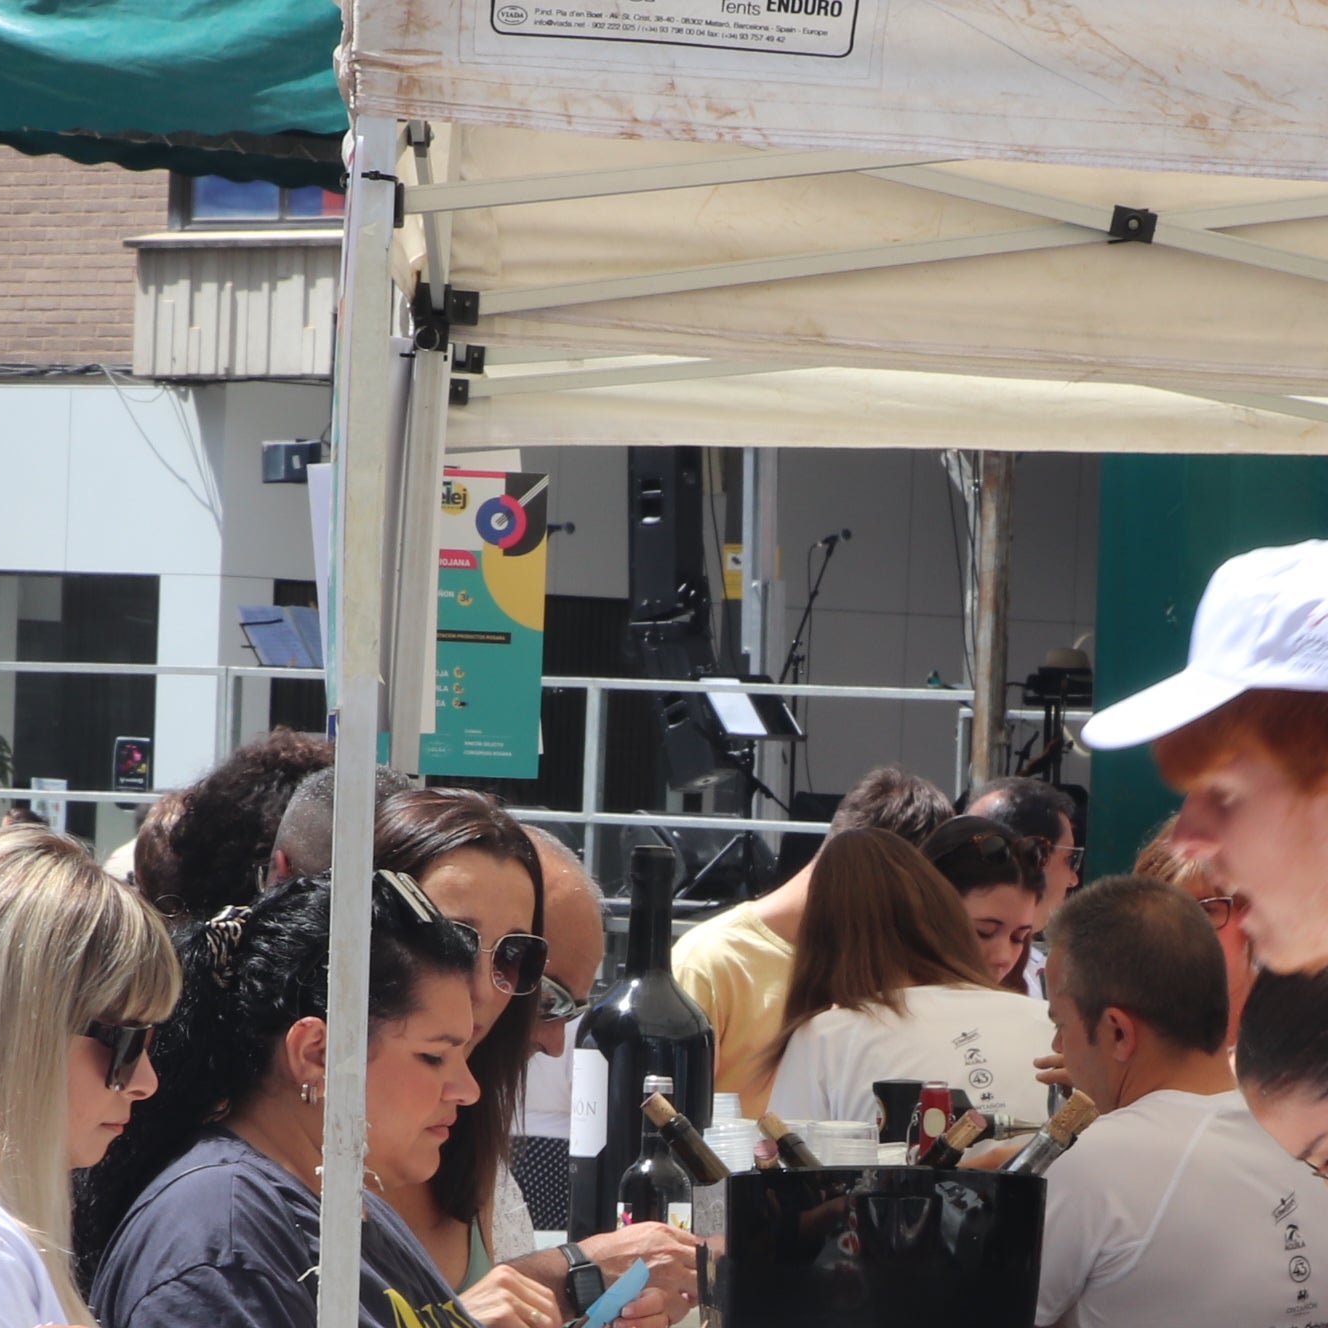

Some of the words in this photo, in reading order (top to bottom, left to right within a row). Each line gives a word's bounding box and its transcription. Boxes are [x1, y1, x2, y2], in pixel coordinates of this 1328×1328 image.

[501, 11, 524, 19] VIADA
[766, 0, 843, 17] ENDURO
[775, 25, 796, 34] Spain
[802, 27, 828, 36] Europe
[972, 1071, 989, 1084] 43
[1292, 1260, 1307, 1277] 43
